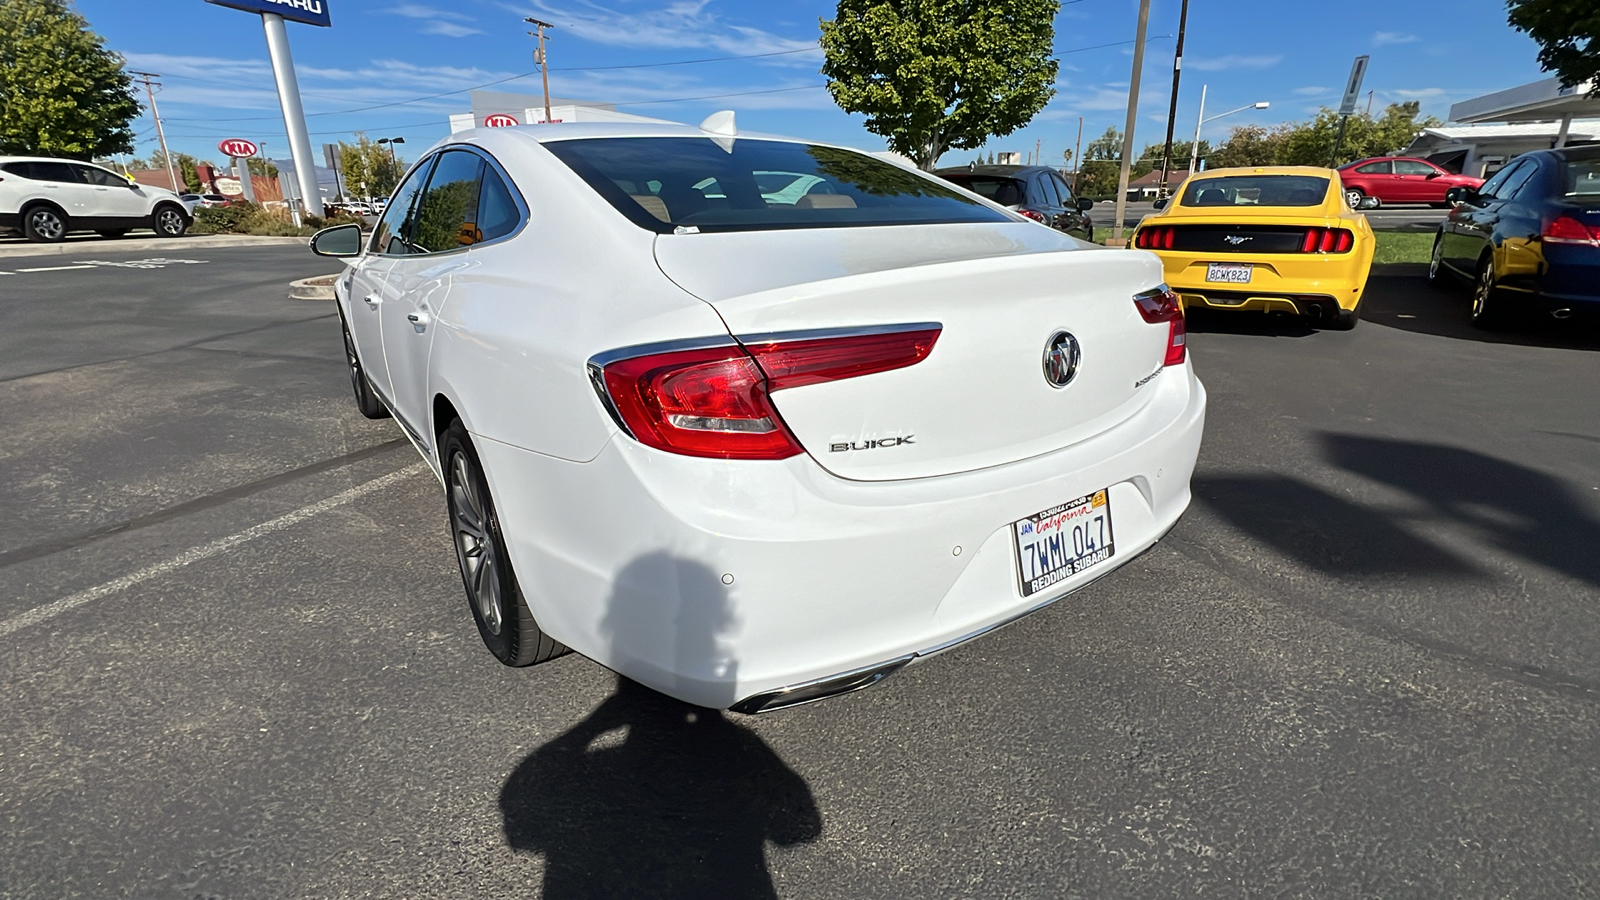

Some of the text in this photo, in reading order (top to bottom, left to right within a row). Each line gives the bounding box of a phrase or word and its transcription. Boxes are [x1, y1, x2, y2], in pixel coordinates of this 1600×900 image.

[227, 142, 254, 155] KIA
[1210, 269, 1249, 280] 8CWK823
[829, 434, 916, 452] BUICK
[1036, 505, 1093, 534] California
[1020, 522, 1033, 536] JAN
[1024, 514, 1104, 579] 7WML047
[1031, 547, 1108, 592] REDDING SUBARU
